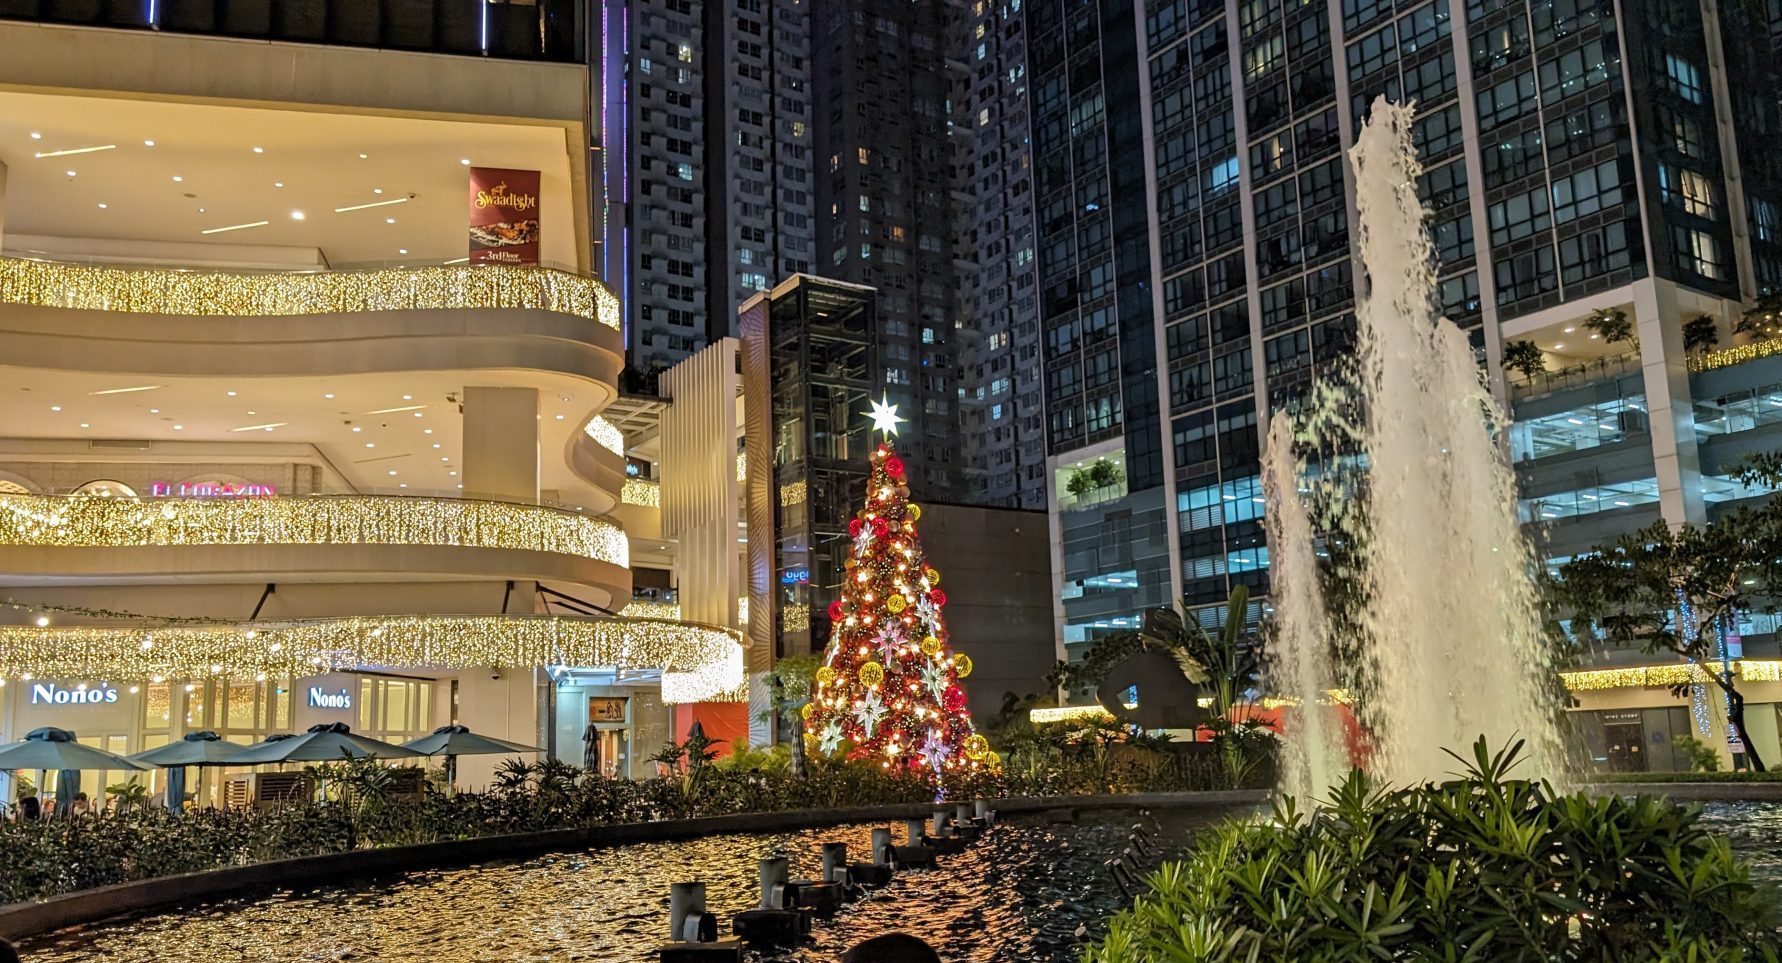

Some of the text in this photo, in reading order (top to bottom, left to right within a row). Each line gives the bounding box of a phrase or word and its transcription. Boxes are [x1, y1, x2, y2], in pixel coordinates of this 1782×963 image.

[475, 190, 536, 212] Swaadisht
[486, 250, 502, 261] 3rd
[32, 682, 118, 704] Nono's
[309, 687, 352, 708] Nono's
